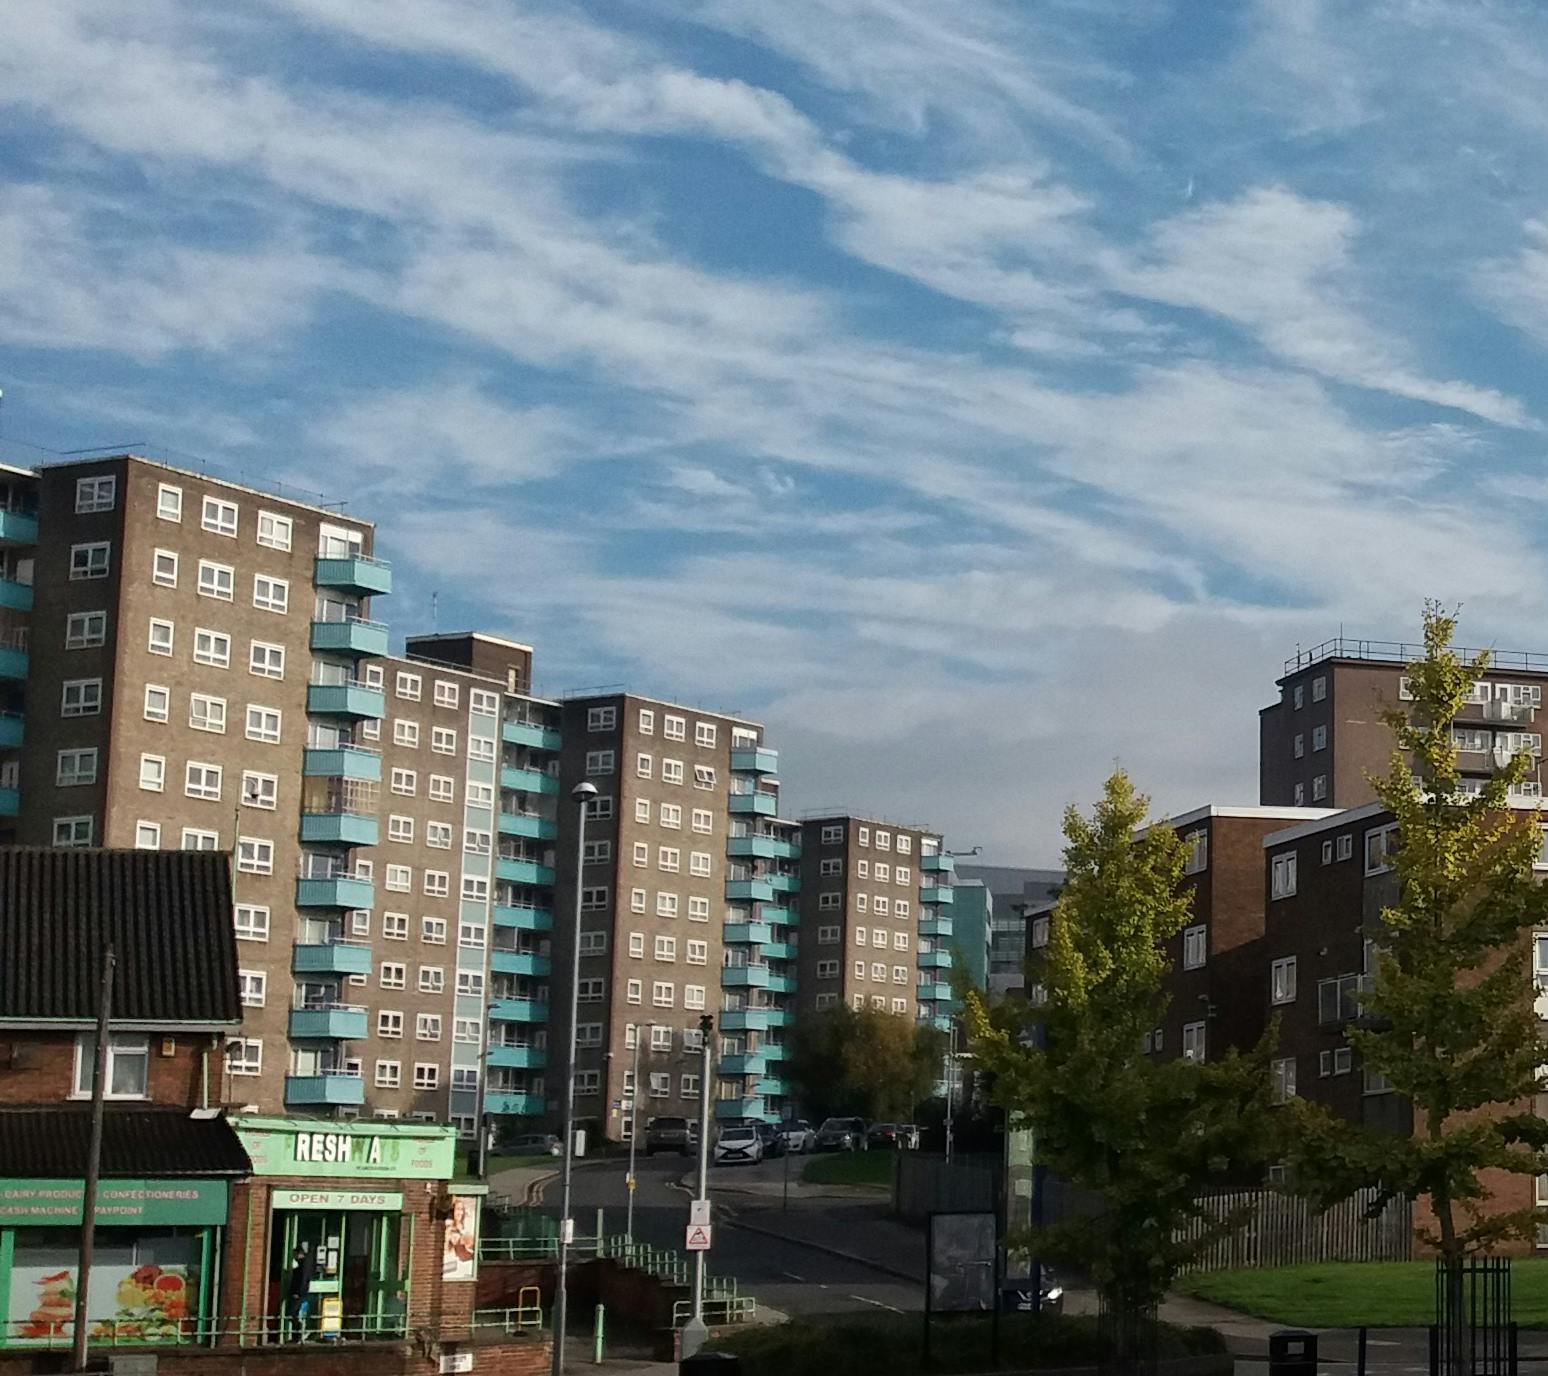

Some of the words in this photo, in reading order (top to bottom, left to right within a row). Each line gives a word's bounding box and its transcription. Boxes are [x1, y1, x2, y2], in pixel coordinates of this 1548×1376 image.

[288, 1193, 330, 1205] OPEN
[336, 1195, 345, 1205] 7
[350, 1195, 387, 1206] DAYS
